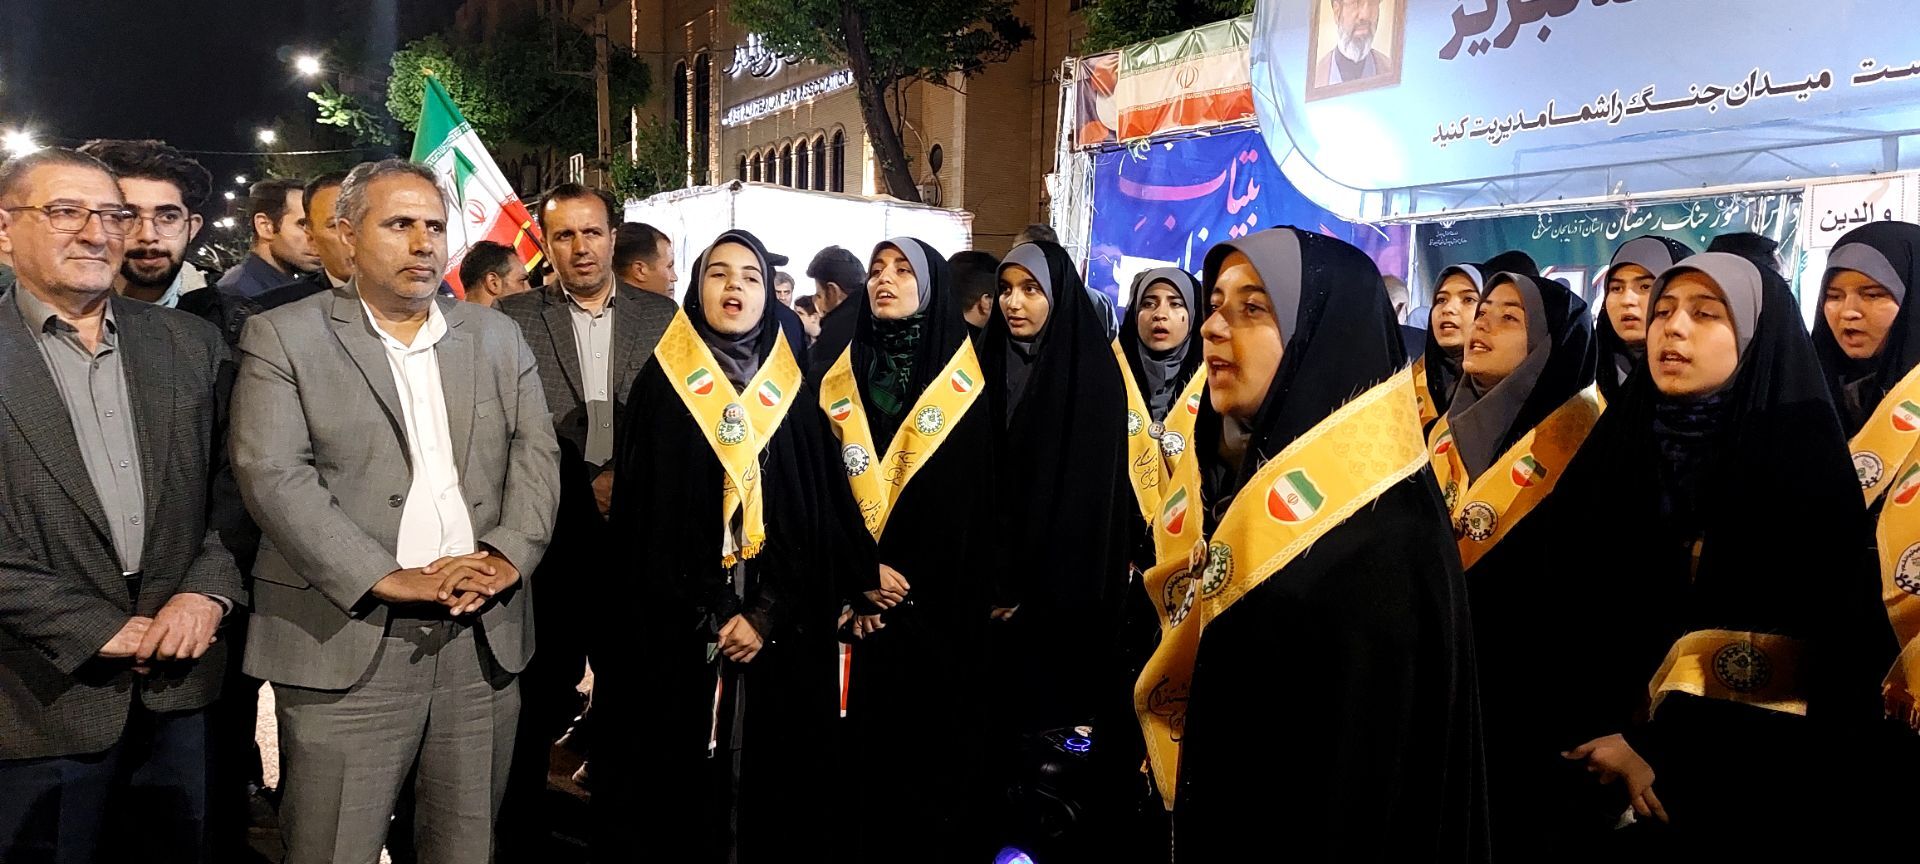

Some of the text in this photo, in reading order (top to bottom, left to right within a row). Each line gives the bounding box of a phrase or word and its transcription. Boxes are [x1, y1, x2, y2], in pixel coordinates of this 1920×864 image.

[1438, 0, 1581, 61] بریز
[1625, 85, 1726, 115] جنگ
[1726, 69, 1831, 106] میدان
[1548, 95, 1610, 126] شما
[1608, 91, 1624, 125] را
[1432, 117, 1469, 148] کنید
[1469, 111, 1547, 145] مدیریت
